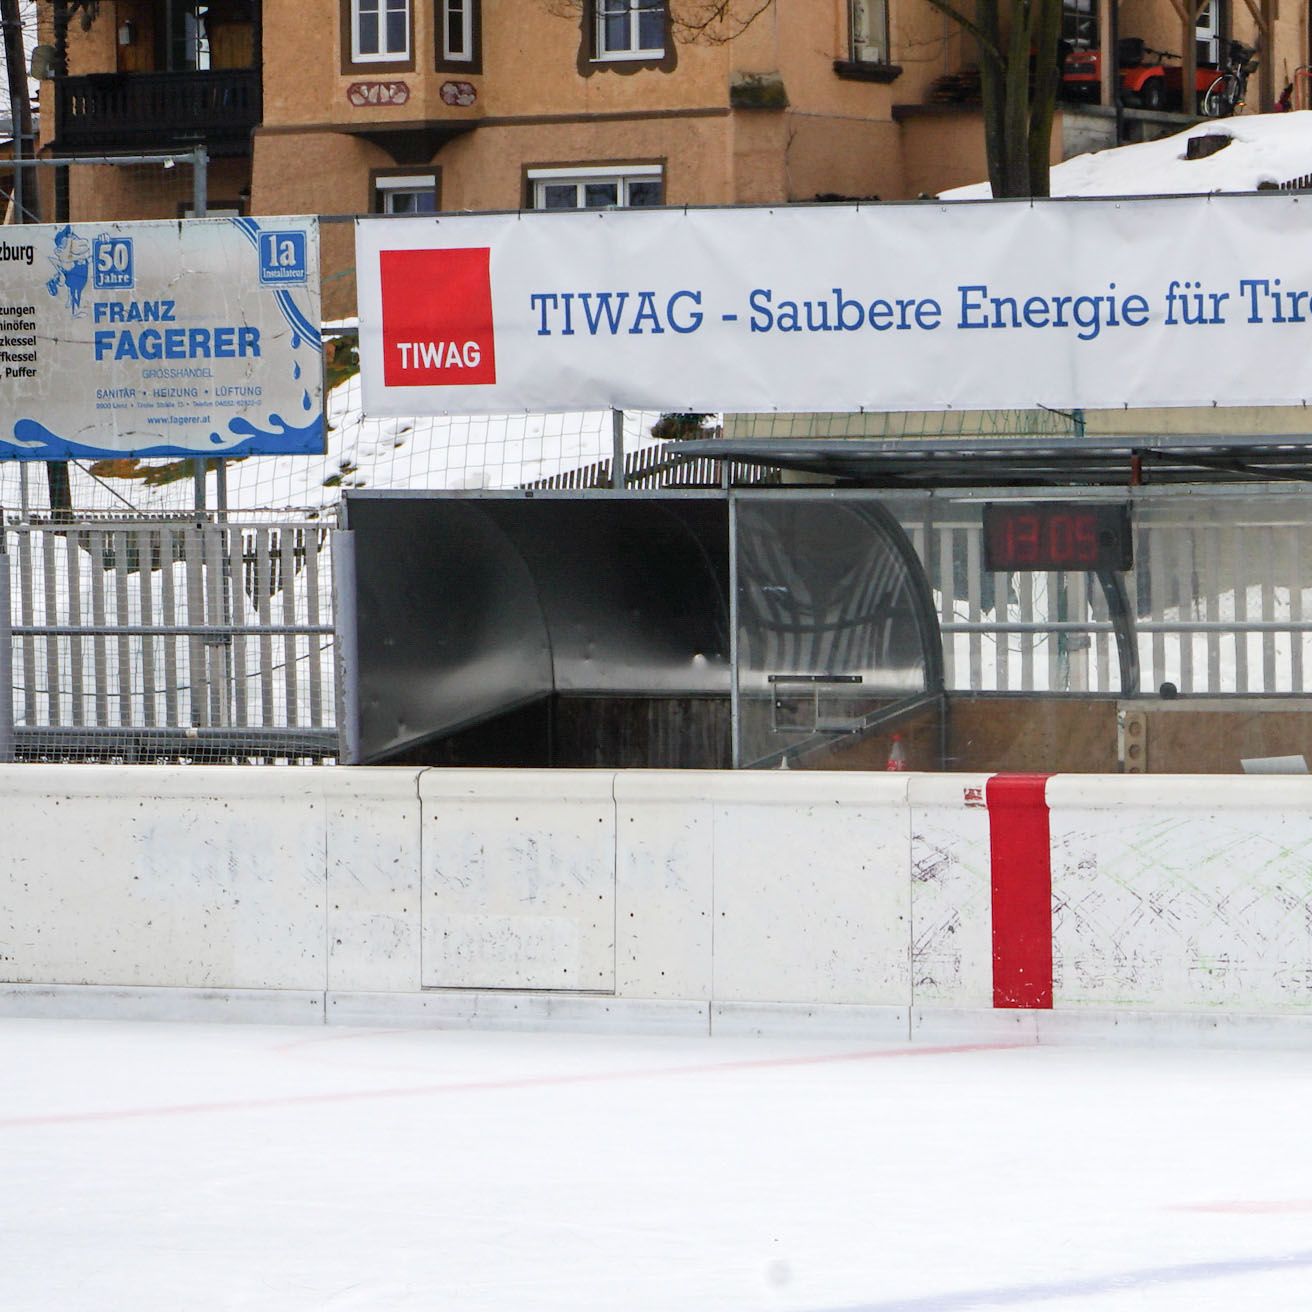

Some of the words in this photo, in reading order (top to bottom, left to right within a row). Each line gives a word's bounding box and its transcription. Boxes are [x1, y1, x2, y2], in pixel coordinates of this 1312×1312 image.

[98, 243, 129, 272] 50
[98, 272, 130, 285] Jahre
[93, 300, 176, 324] FRANZ
[531, 290, 703, 336] TIWAG
[750, 288, 942, 333] Saubere
[957, 283, 1150, 341] Energie
[1164, 281, 1230, 325] für
[94, 327, 261, 361] FAGERER
[396, 341, 481, 369] TIWAG
[5, 367, 37, 377] Puffer
[96, 388, 136, 399] SANITÄR
[153, 387, 198, 398] HEIZUNG
[215, 386, 262, 397] LÜFTUNG
[147, 414, 211, 426] www.fagerer.at
